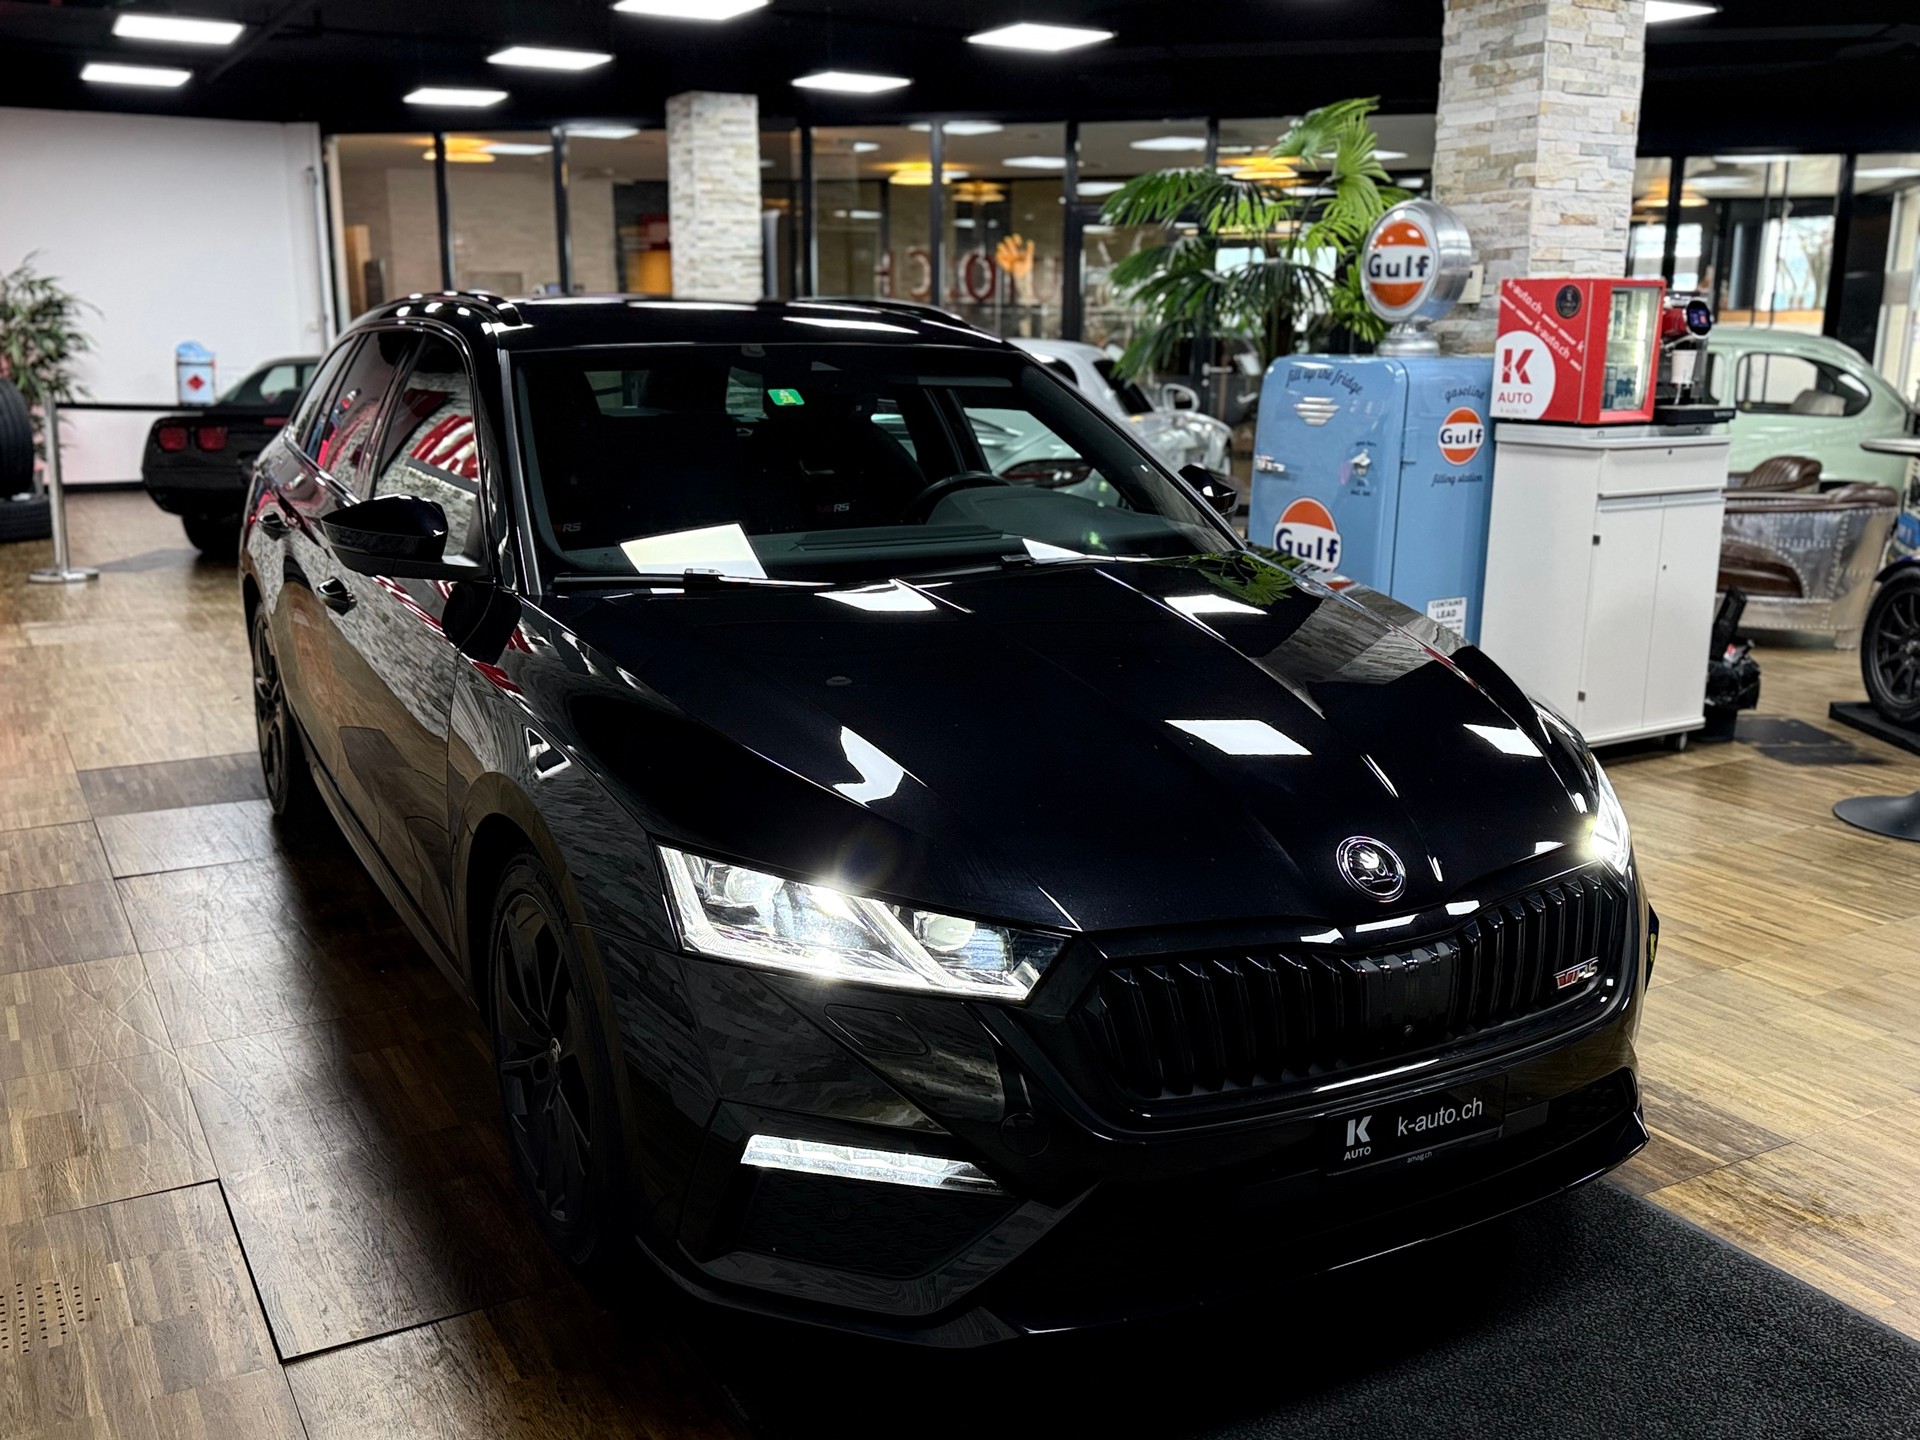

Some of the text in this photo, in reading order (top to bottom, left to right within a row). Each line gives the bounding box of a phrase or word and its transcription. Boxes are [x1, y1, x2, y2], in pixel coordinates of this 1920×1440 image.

[1368, 254, 1430, 278] Gulf
[1506, 279, 1542, 314] k-auto.ch
[1533, 321, 1570, 359] k-auto.ch
[1501, 348, 1534, 384] K
[1285, 369, 1302, 388] fill
[1303, 371, 1316, 382] up
[1329, 369, 1364, 395] fridge
[1444, 385, 1485, 404] gasoline
[1497, 392, 1533, 404] AUTO
[1440, 428, 1482, 444] Gulf
[1430, 472, 1483, 487] filling station
[1276, 528, 1339, 562] Gulf
[1431, 599, 1463, 609] CONTAINS
[1436, 609, 1457, 619] LEAD
[1397, 1097, 1483, 1137] k-auto.ch
[1346, 1115, 1373, 1147] K
[1343, 1146, 1372, 1161] AUTO
[1406, 1151, 1433, 1164] amag.ch
